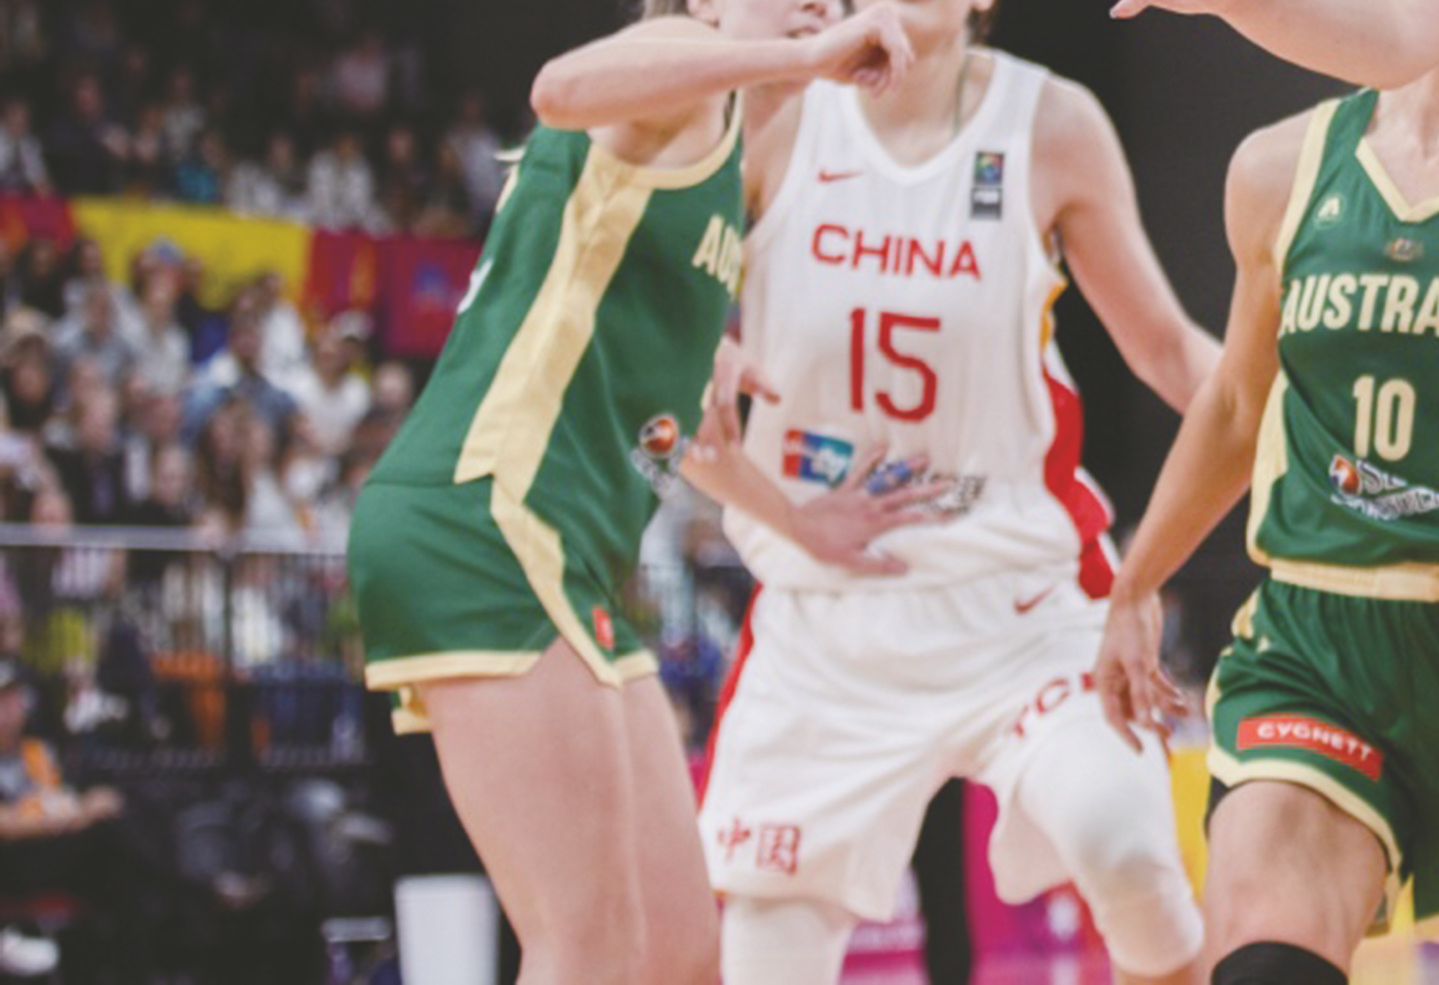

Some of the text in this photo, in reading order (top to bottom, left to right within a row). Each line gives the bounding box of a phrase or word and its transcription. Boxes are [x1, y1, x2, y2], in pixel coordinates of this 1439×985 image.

[811, 222, 984, 281] CHINA
[849, 306, 942, 425] 15
[1352, 374, 1416, 462] 10
[1257, 721, 1371, 761] CYGNETT
[715, 815, 802, 876] 中国
